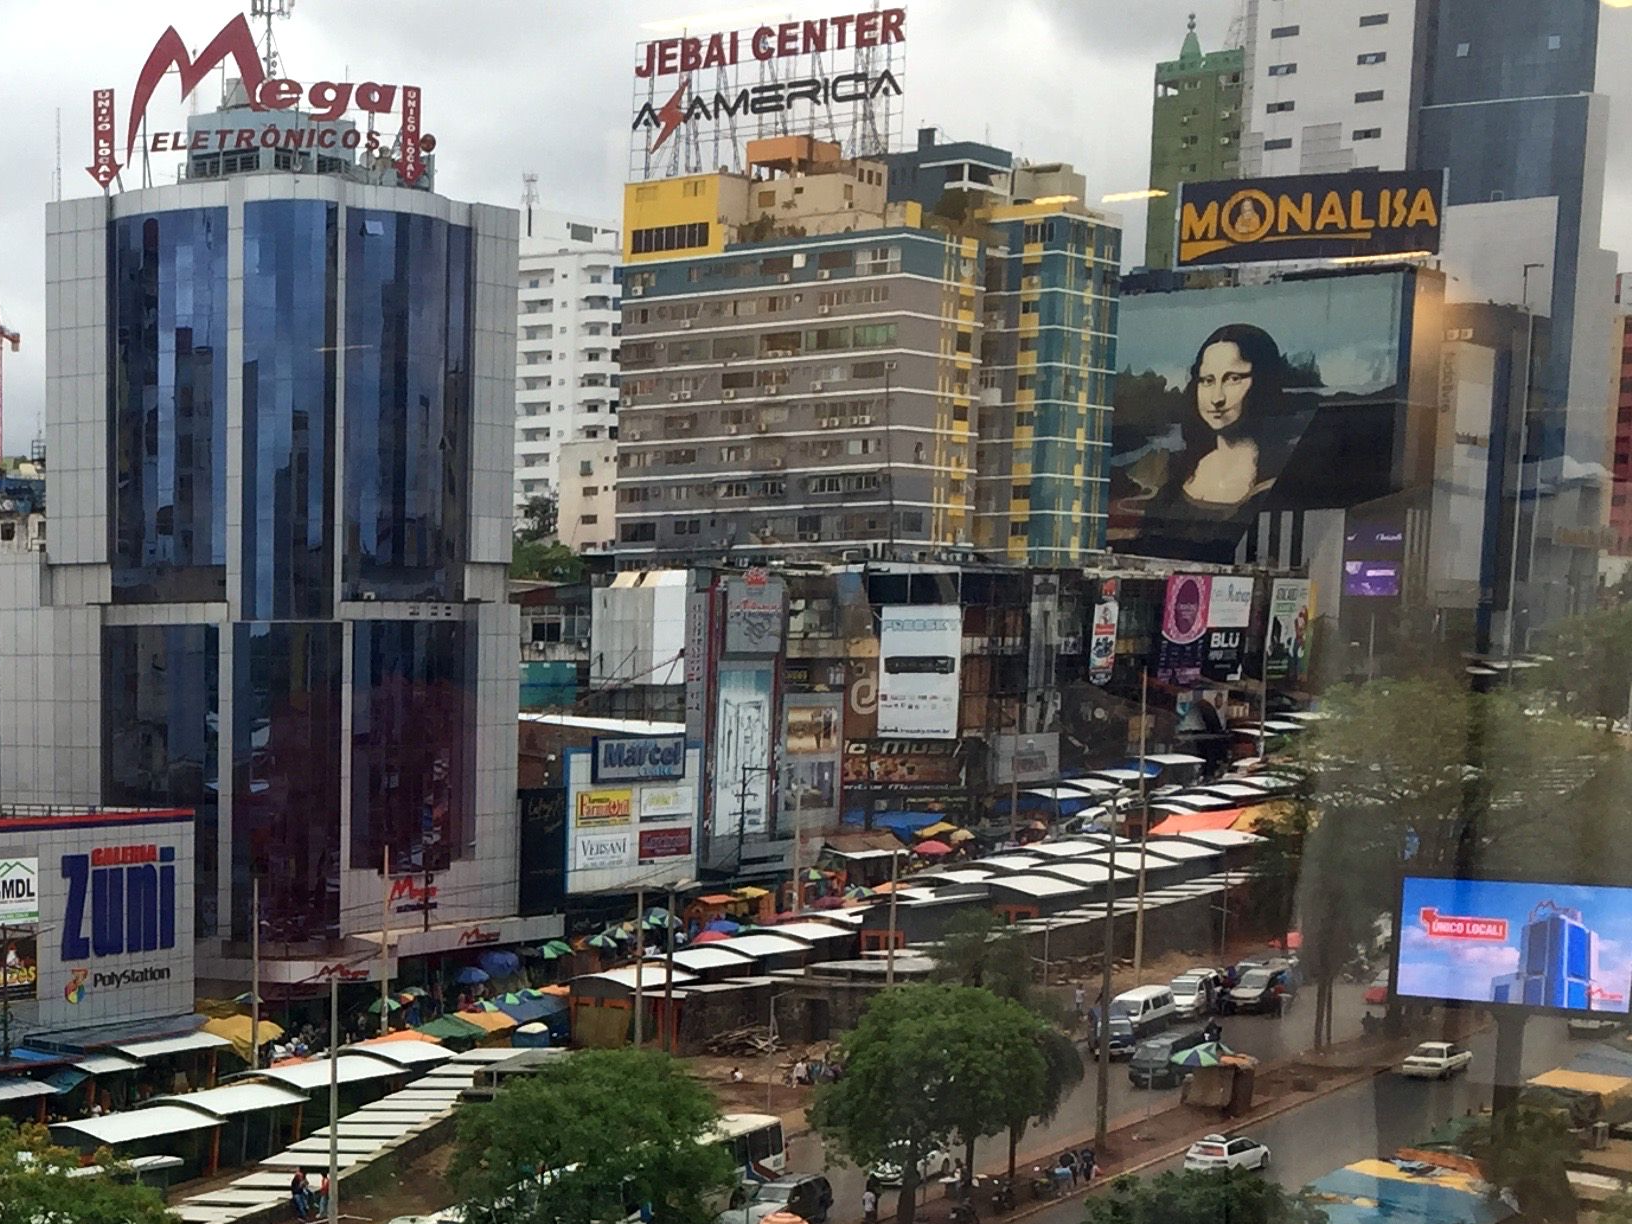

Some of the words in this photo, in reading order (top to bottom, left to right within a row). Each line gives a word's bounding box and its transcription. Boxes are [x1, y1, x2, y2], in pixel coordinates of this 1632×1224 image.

[635, 31, 738, 78] JEBAI
[752, 8, 906, 61] CENTER
[127, 12, 396, 168] Mega
[684, 69, 903, 121] AMERICA
[1181, 187, 1438, 242] MONALISA
[1210, 632, 1240, 648] BLU
[1, 878, 35, 899] MDL
[93, 966, 170, 988] PolyStation
